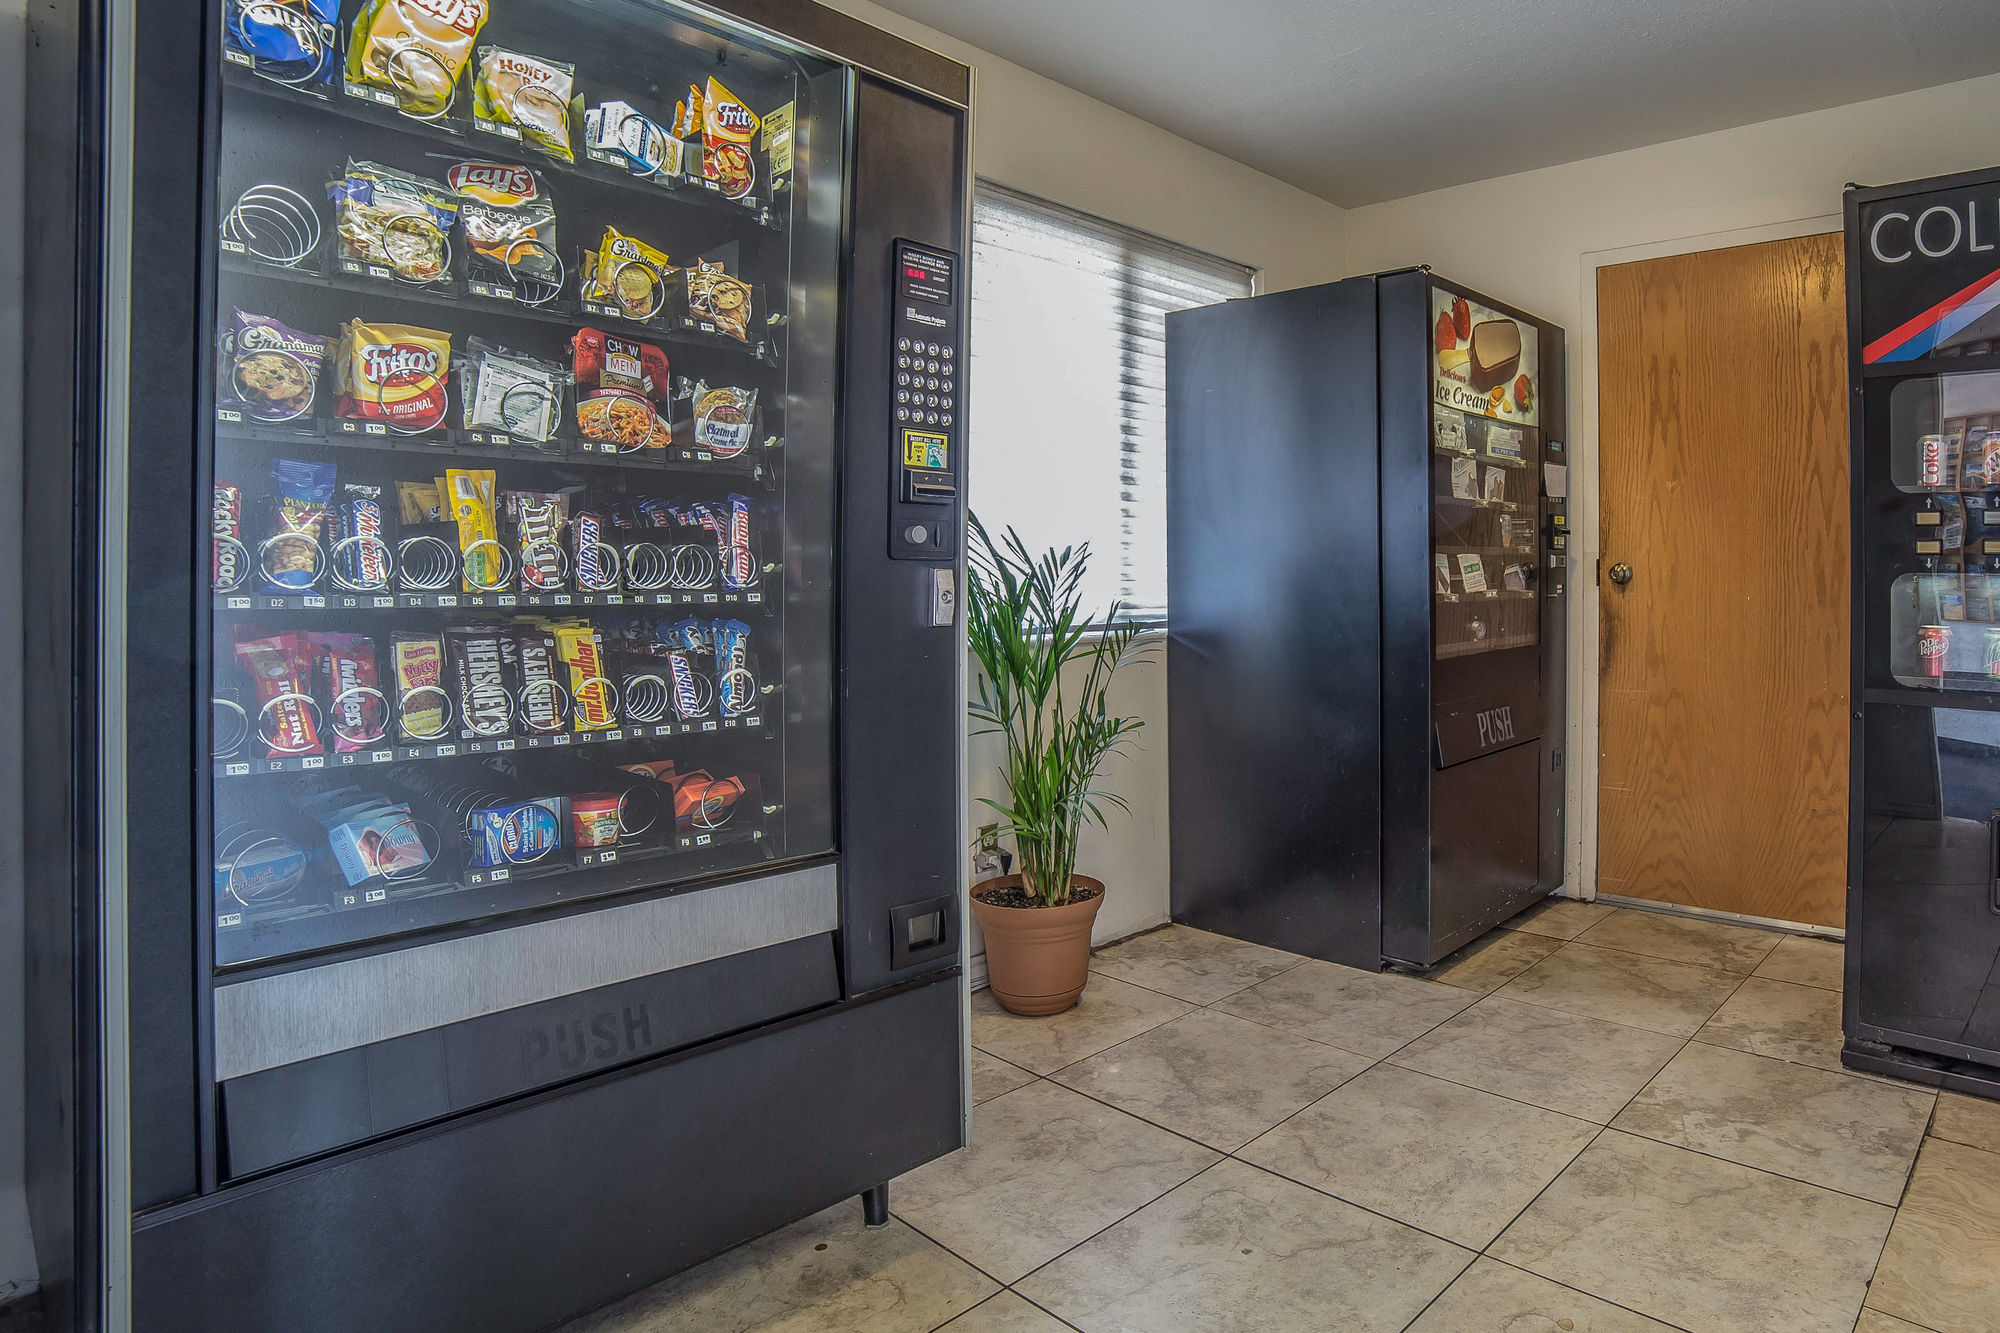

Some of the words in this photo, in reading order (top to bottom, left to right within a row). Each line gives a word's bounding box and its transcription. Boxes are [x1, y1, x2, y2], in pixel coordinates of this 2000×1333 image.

[499, 59, 552, 83] HONEY
[457, 165, 529, 194] Lay's
[462, 203, 532, 224] Barbecue
[1870, 197, 2000, 263] COL
[346, 262, 360, 272] B3
[475, 286, 487, 295] B5
[607, 339, 639, 357] CHOW
[361, 344, 439, 383] Fritos
[610, 358, 637, 374] MEIN
[1440, 366, 1466, 384] Delicious
[605, 373, 644, 391] Premium
[1436, 380, 1450, 401] Ice
[1453, 386, 1490, 411] Cream
[392, 398, 434, 414] ORIGINAL
[221, 412, 240, 420] 100
[369, 425, 384, 433] 100
[472, 433, 483, 442] C5
[582, 442, 593, 451] C7
[1923, 442, 1939, 486] Coke
[578, 517, 599, 588] SNICKERS
[232, 598, 250, 607] 100
[270, 598, 284, 607] D2
[343, 598, 356, 606] D3
[377, 598, 392, 606] 100
[410, 597, 422, 606] D4
[441, 597, 456, 605] 100
[472, 597, 484, 605] D5
[501, 597, 515, 605] 100
[557, 596, 570, 604] 100
[583, 595, 594, 604] D7
[609, 595, 622, 603] 100
[659, 595, 671, 603] 100
[682, 594, 692, 603] D9
[706, 594, 717, 602] 100
[725, 594, 738, 602] D10
[1919, 639, 1947, 656] Pepper
[402, 660, 439, 678] Nutty
[458, 659, 466, 675] MILK
[466, 640, 510, 733] HERSHEY'S
[523, 648, 554, 721] HERSHEY'S
[289, 714, 304, 746] Nut
[658, 726, 669, 734] 100
[705, 722, 716, 730] 100
[1476, 706, 1515, 747] PUSH
[582, 733, 592, 742] E7
[608, 731, 621, 739] 100
[556, 736, 569, 744] 100
[471, 743, 481, 751] E5
[500, 741, 514, 749] 100
[409, 749, 420, 757] E4
[440, 746, 455, 755] 100
[342, 755, 354, 764] E3
[375, 752, 391, 761] 100
[270, 761, 282, 771] E2
[306, 758, 323, 768] 100
[231, 764, 248, 774] 100
[383, 833, 416, 848] Downy
[522, 834, 531, 853] Stain
[681, 838, 690, 847] F9
[583, 856, 593, 864] F7
[471, 874, 482, 884] F5
[494, 870, 507, 879] 100
[343, 896, 356, 905] F3
[222, 914, 240, 925] 100
[520, 1002, 653, 1080] PUSH
